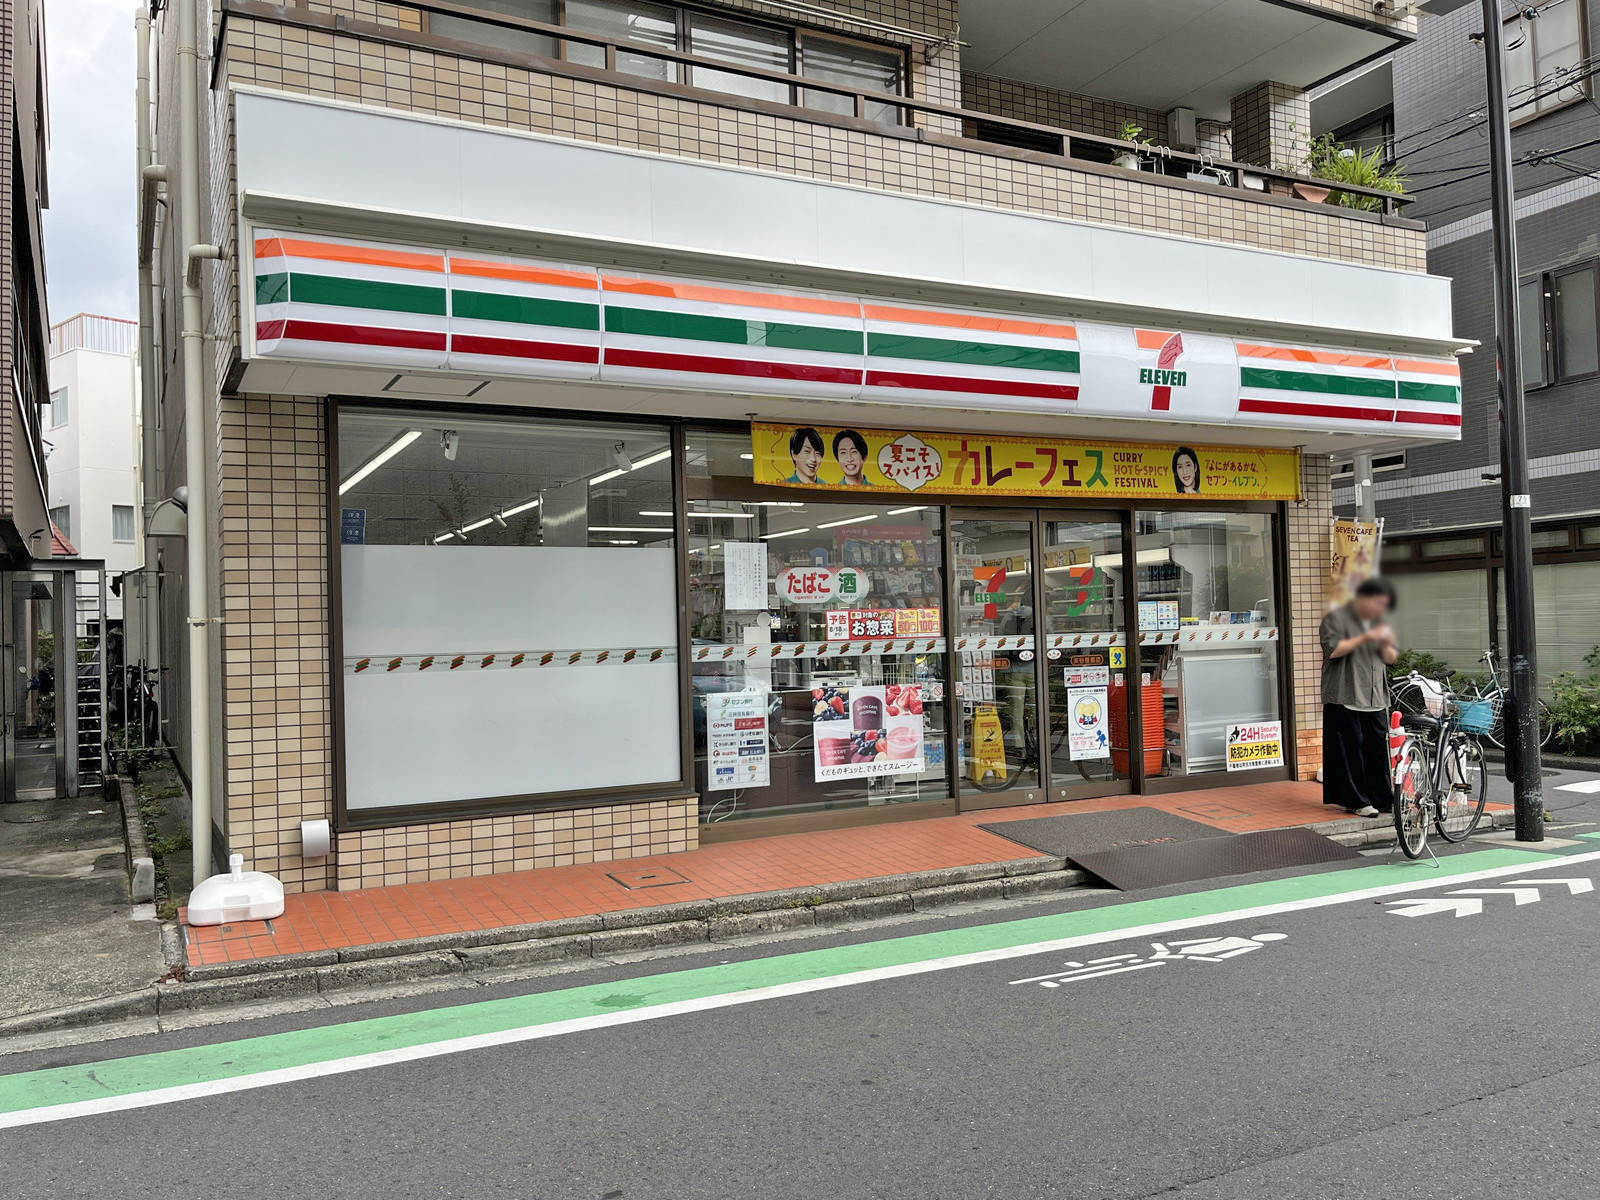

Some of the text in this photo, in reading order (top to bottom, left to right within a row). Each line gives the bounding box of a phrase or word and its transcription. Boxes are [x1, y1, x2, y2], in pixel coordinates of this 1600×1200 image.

[890, 444, 930, 464] 夏こそ
[1113, 452, 1143, 463] CURRY
[948, 440, 1108, 488] カレーフェス
[1115, 477, 1158, 489] FESTIVAL
[1335, 526, 1356, 535] SEVEN
[787, 572, 831, 594] たばこ
[838, 572, 857, 594] 酒
[829, 614, 847, 625] 予告
[852, 619, 894, 636] お惣菜
[1240, 727, 1260, 741] 24H
[1230, 743, 1279, 760] 防犯カメラ作動中
